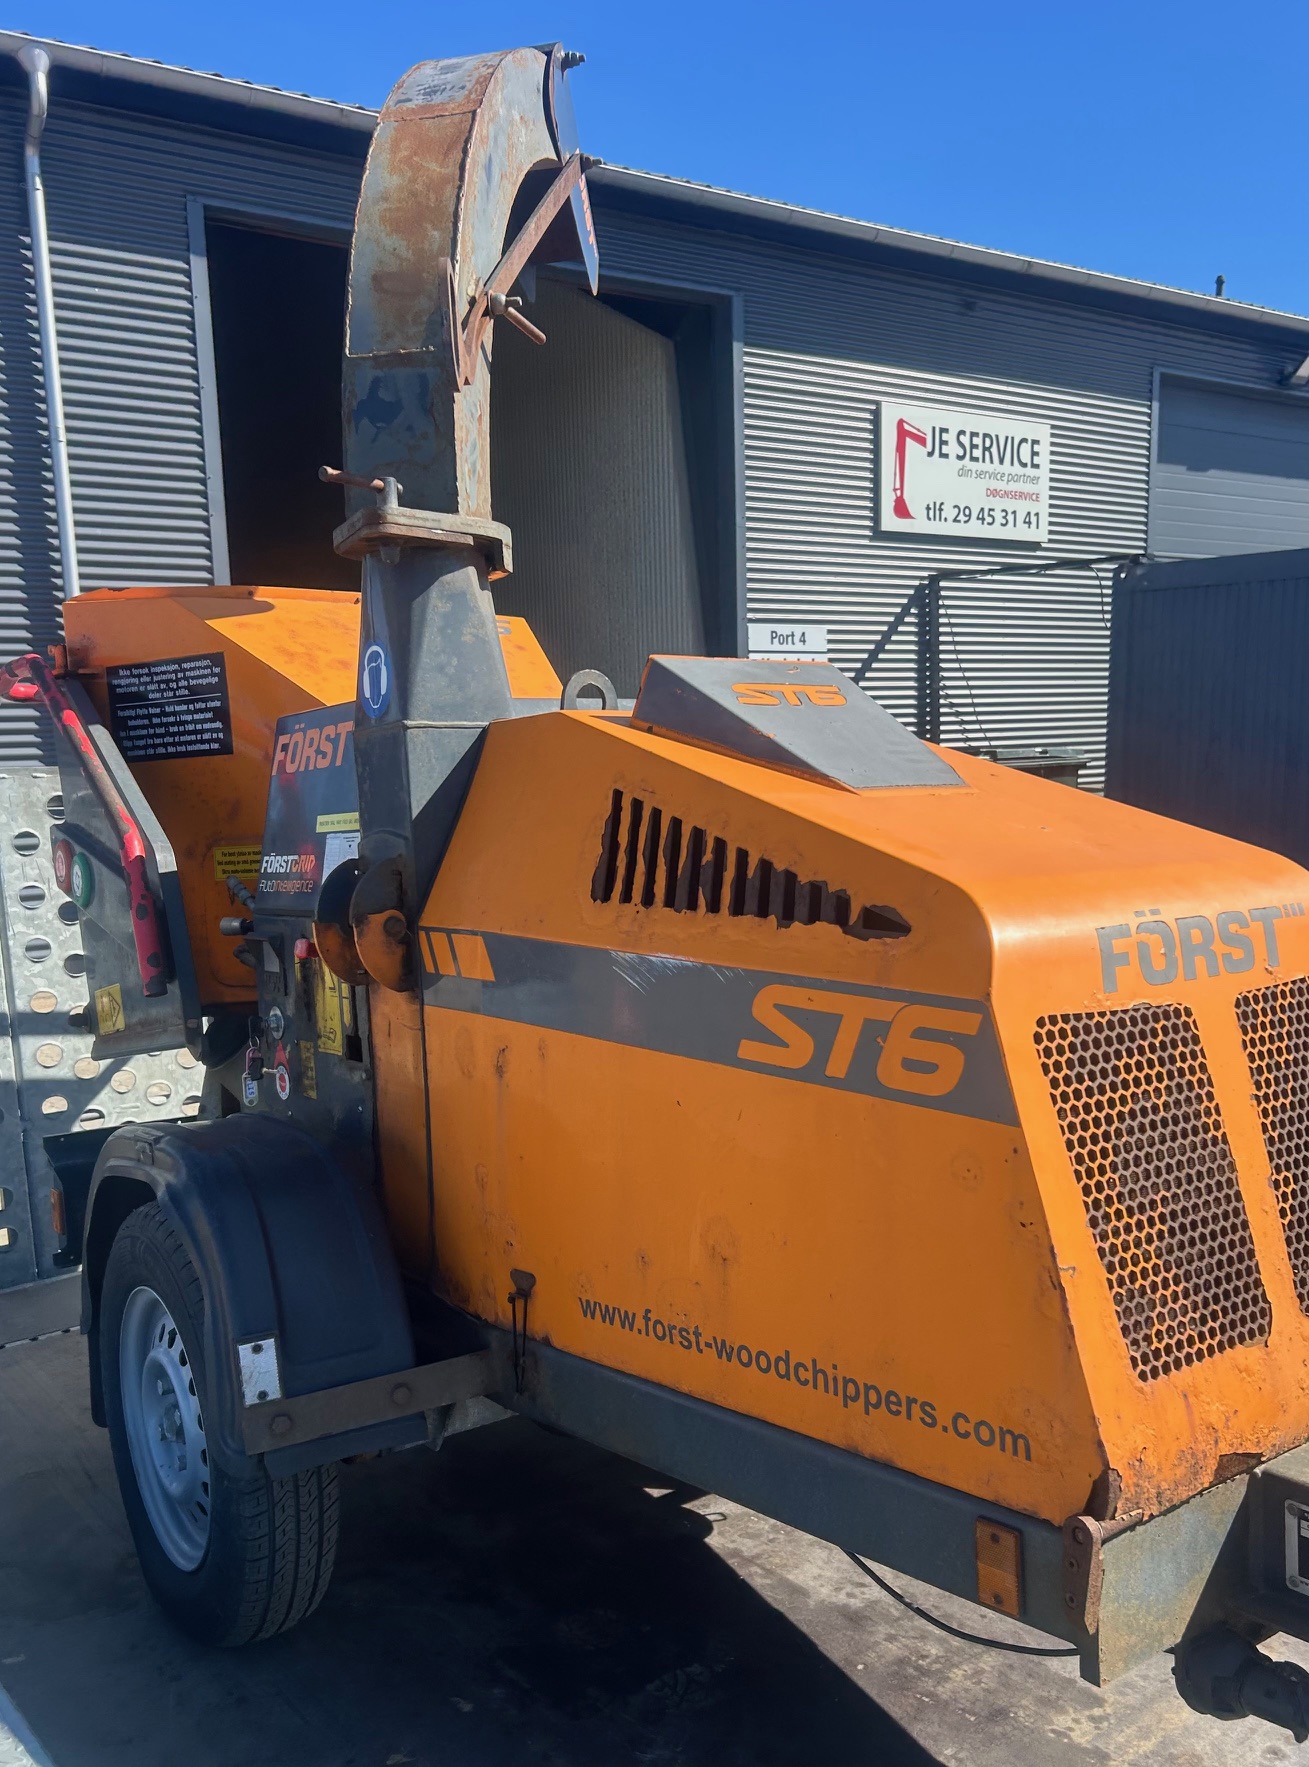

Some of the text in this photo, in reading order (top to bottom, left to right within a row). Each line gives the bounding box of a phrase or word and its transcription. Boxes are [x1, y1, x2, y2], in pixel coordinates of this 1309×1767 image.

[926, 426, 1041, 470] JE SERVICE
[958, 465, 1040, 486] din service partner
[986, 487, 1040, 502] DØGNSERVICE
[926, 502, 1040, 530] tlf. 29 45 31 41
[770, 630, 806, 646] Port 4
[186, 668, 211, 677] maskinen
[190, 676, 218, 685] bevegelige
[731, 682, 848, 706] ST6
[272, 720, 355, 776] FÖRST
[1096, 907, 1286, 994] FÖRST
[736, 984, 983, 1097] ST6
[578, 1296, 1032, 1462] www.forst-woodchippers.com
